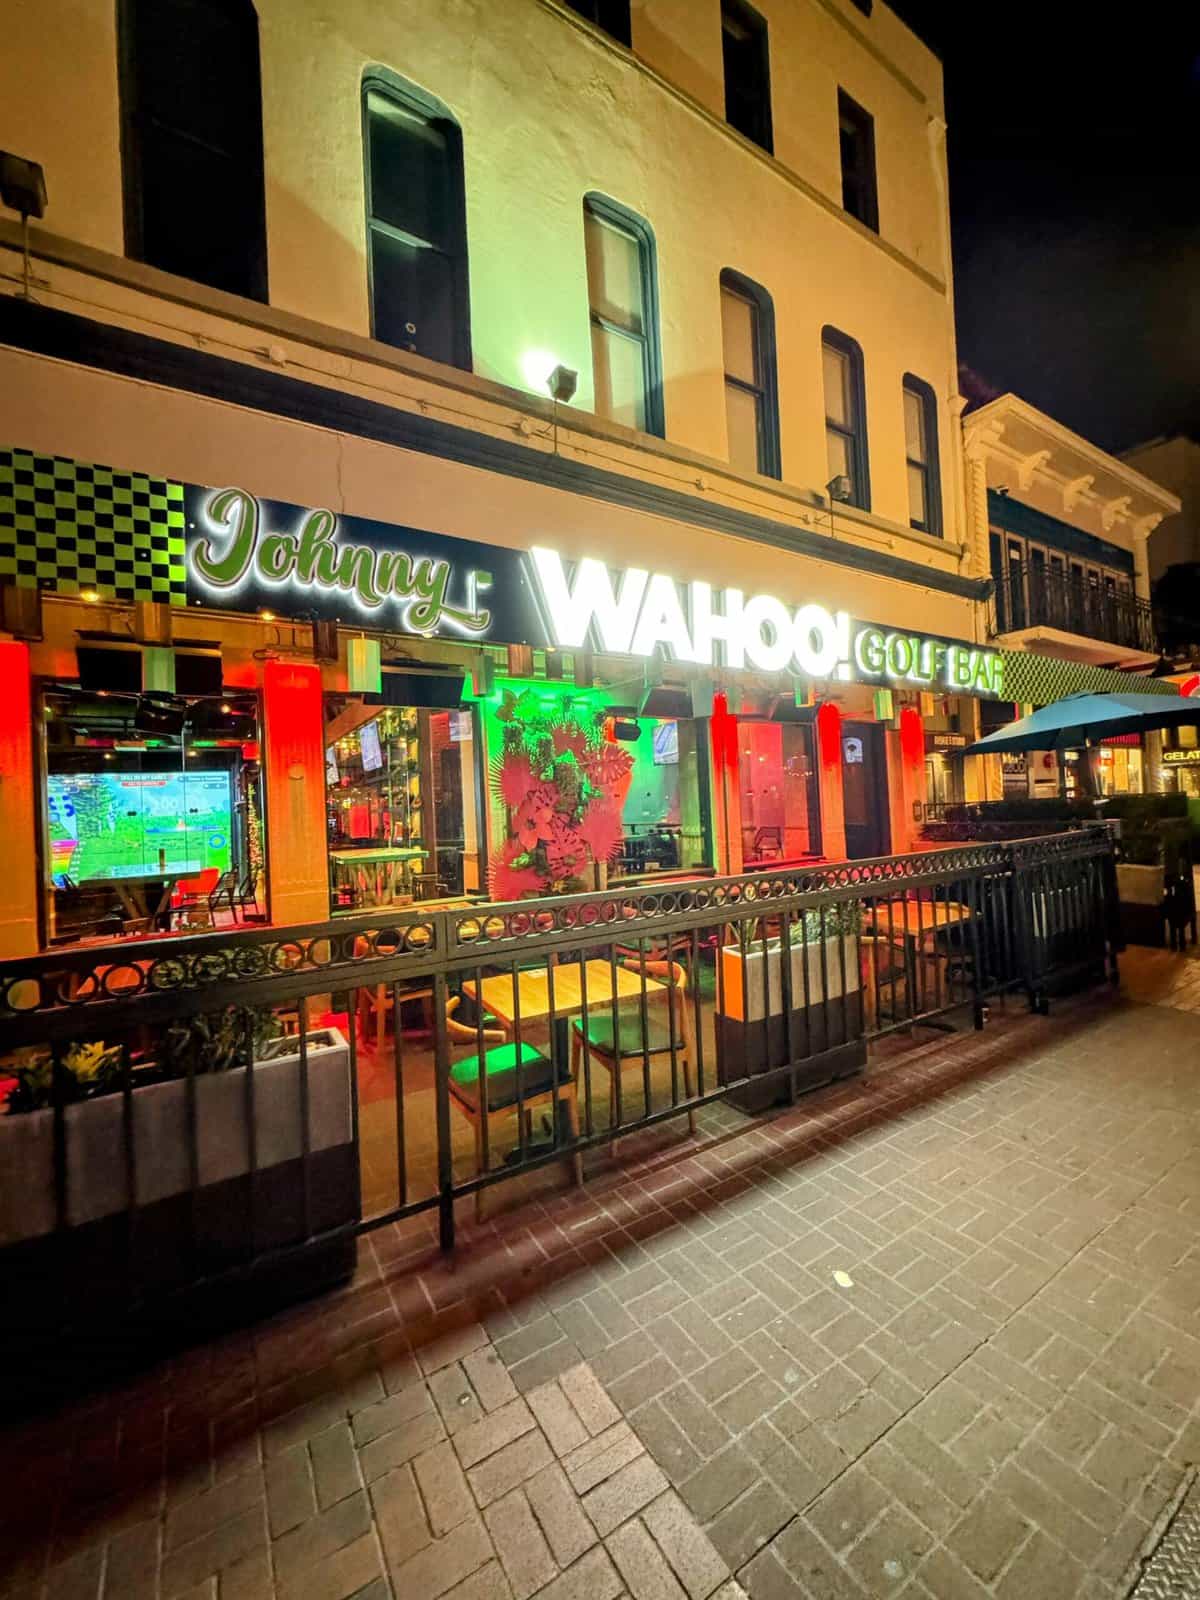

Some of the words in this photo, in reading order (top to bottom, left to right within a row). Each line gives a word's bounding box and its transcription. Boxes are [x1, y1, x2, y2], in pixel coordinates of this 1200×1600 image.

[191, 488, 490, 631] Johnny
[521, 545, 852, 681] WAHOO!
[855, 628, 946, 681] GOLF
[949, 646, 1004, 694] BAR
